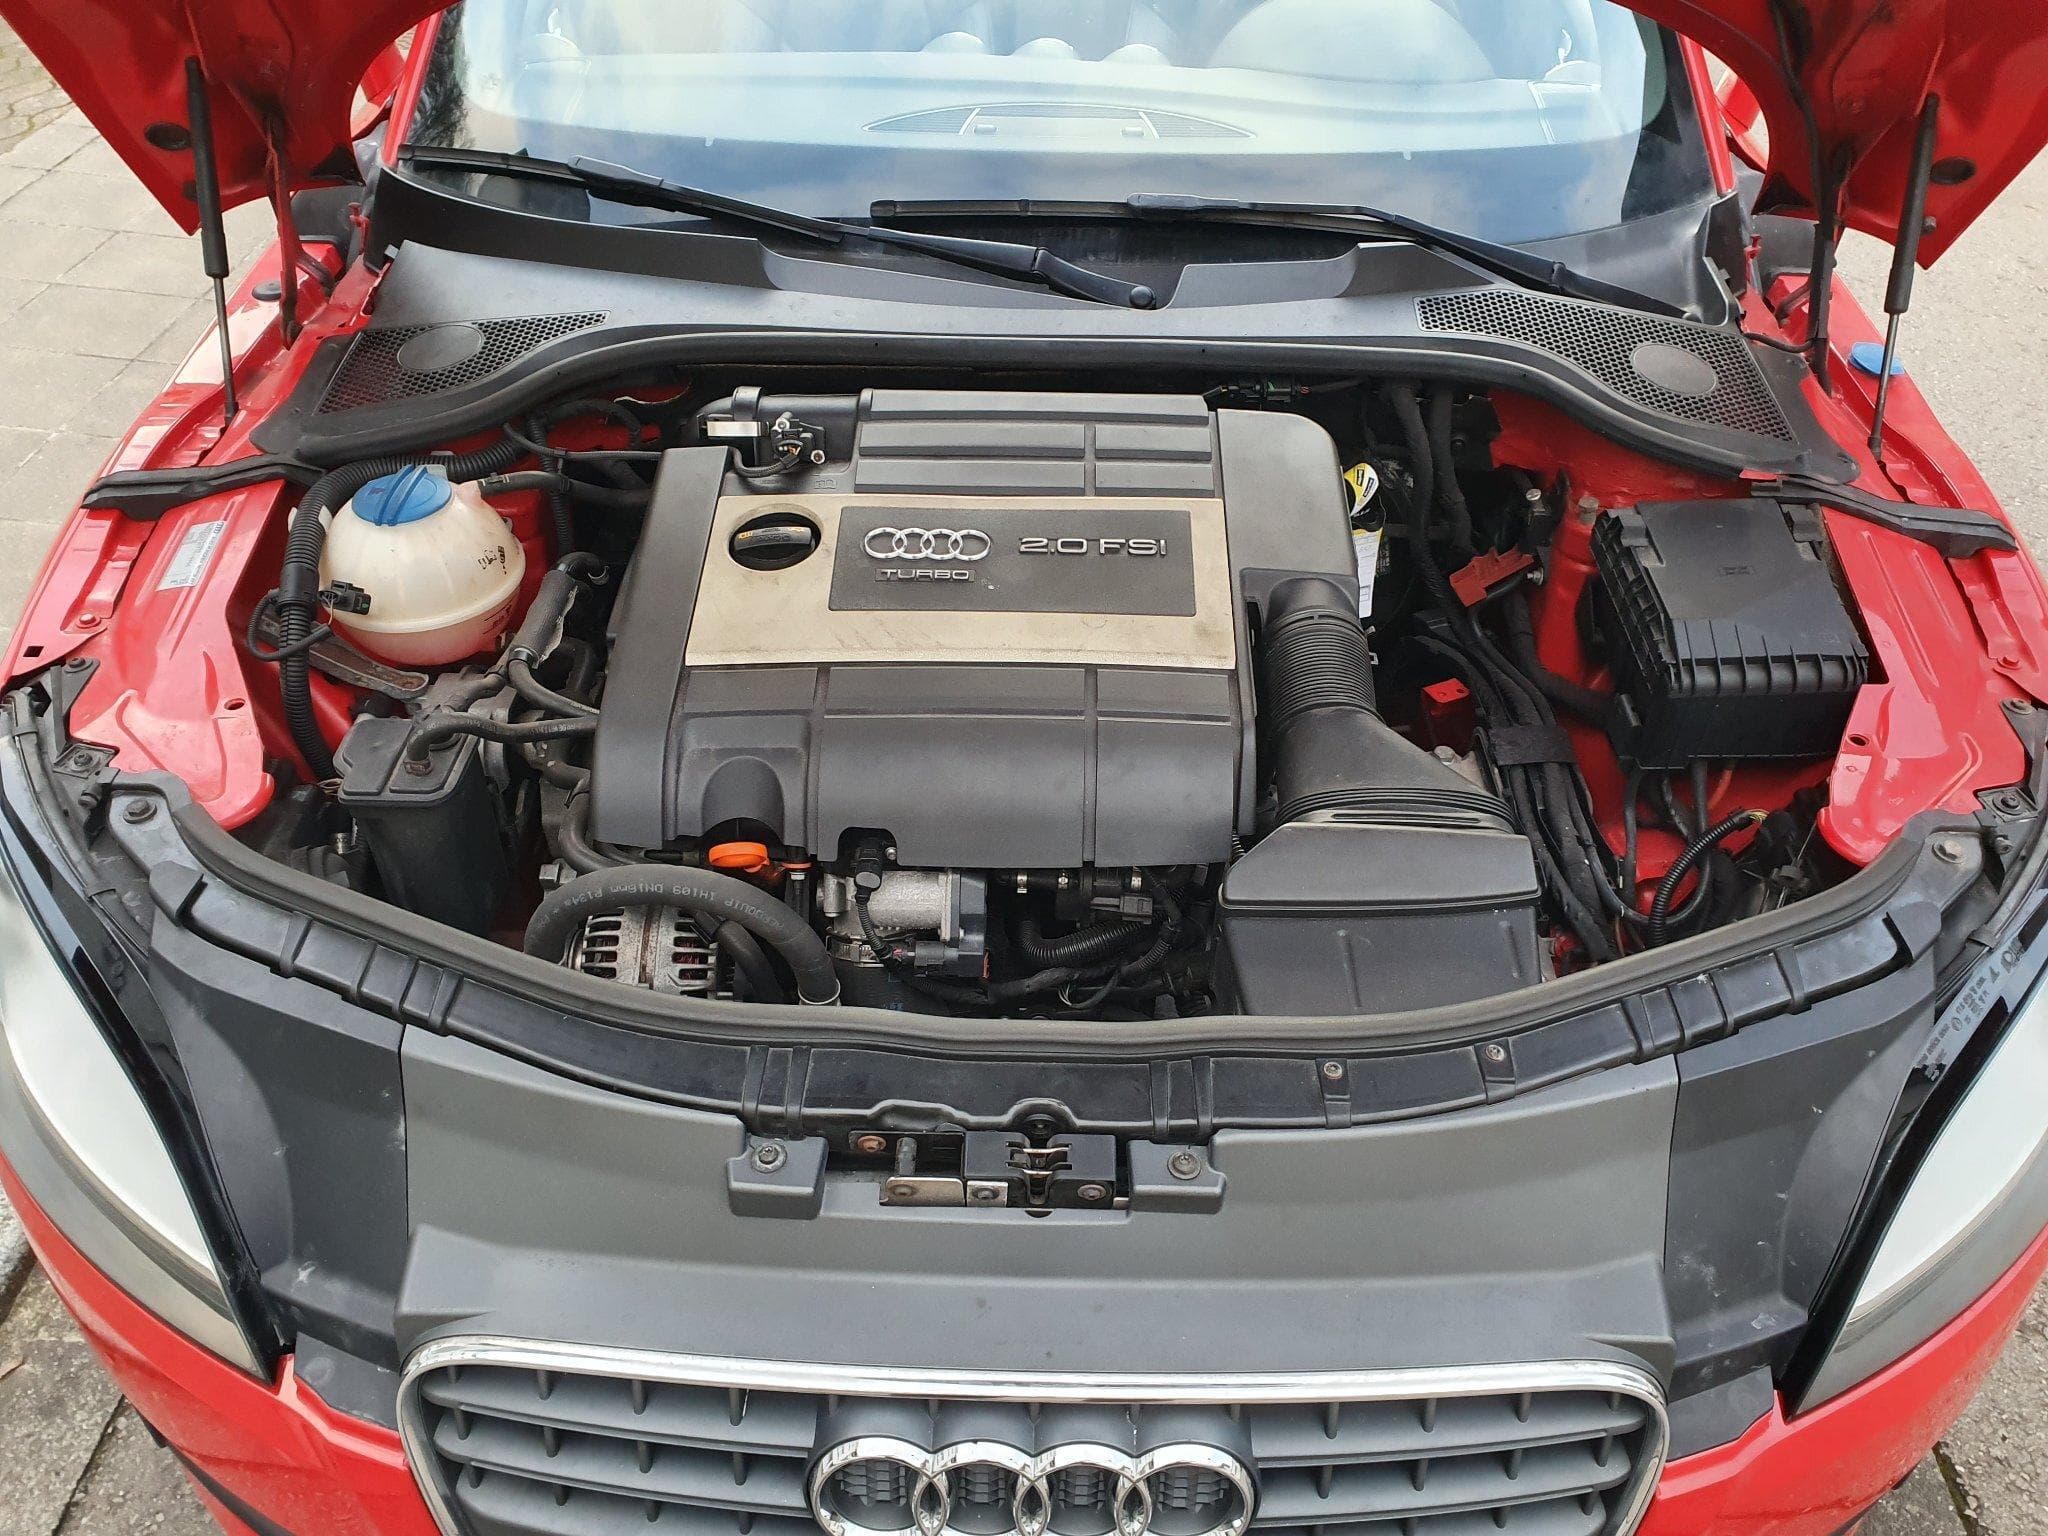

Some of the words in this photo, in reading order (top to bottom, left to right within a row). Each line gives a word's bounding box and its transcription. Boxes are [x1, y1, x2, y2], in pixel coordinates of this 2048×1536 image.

[1019, 537, 1088, 554] 2.0
[1099, 538, 1168, 556] FSI
[880, 568, 970, 580] TURBO
